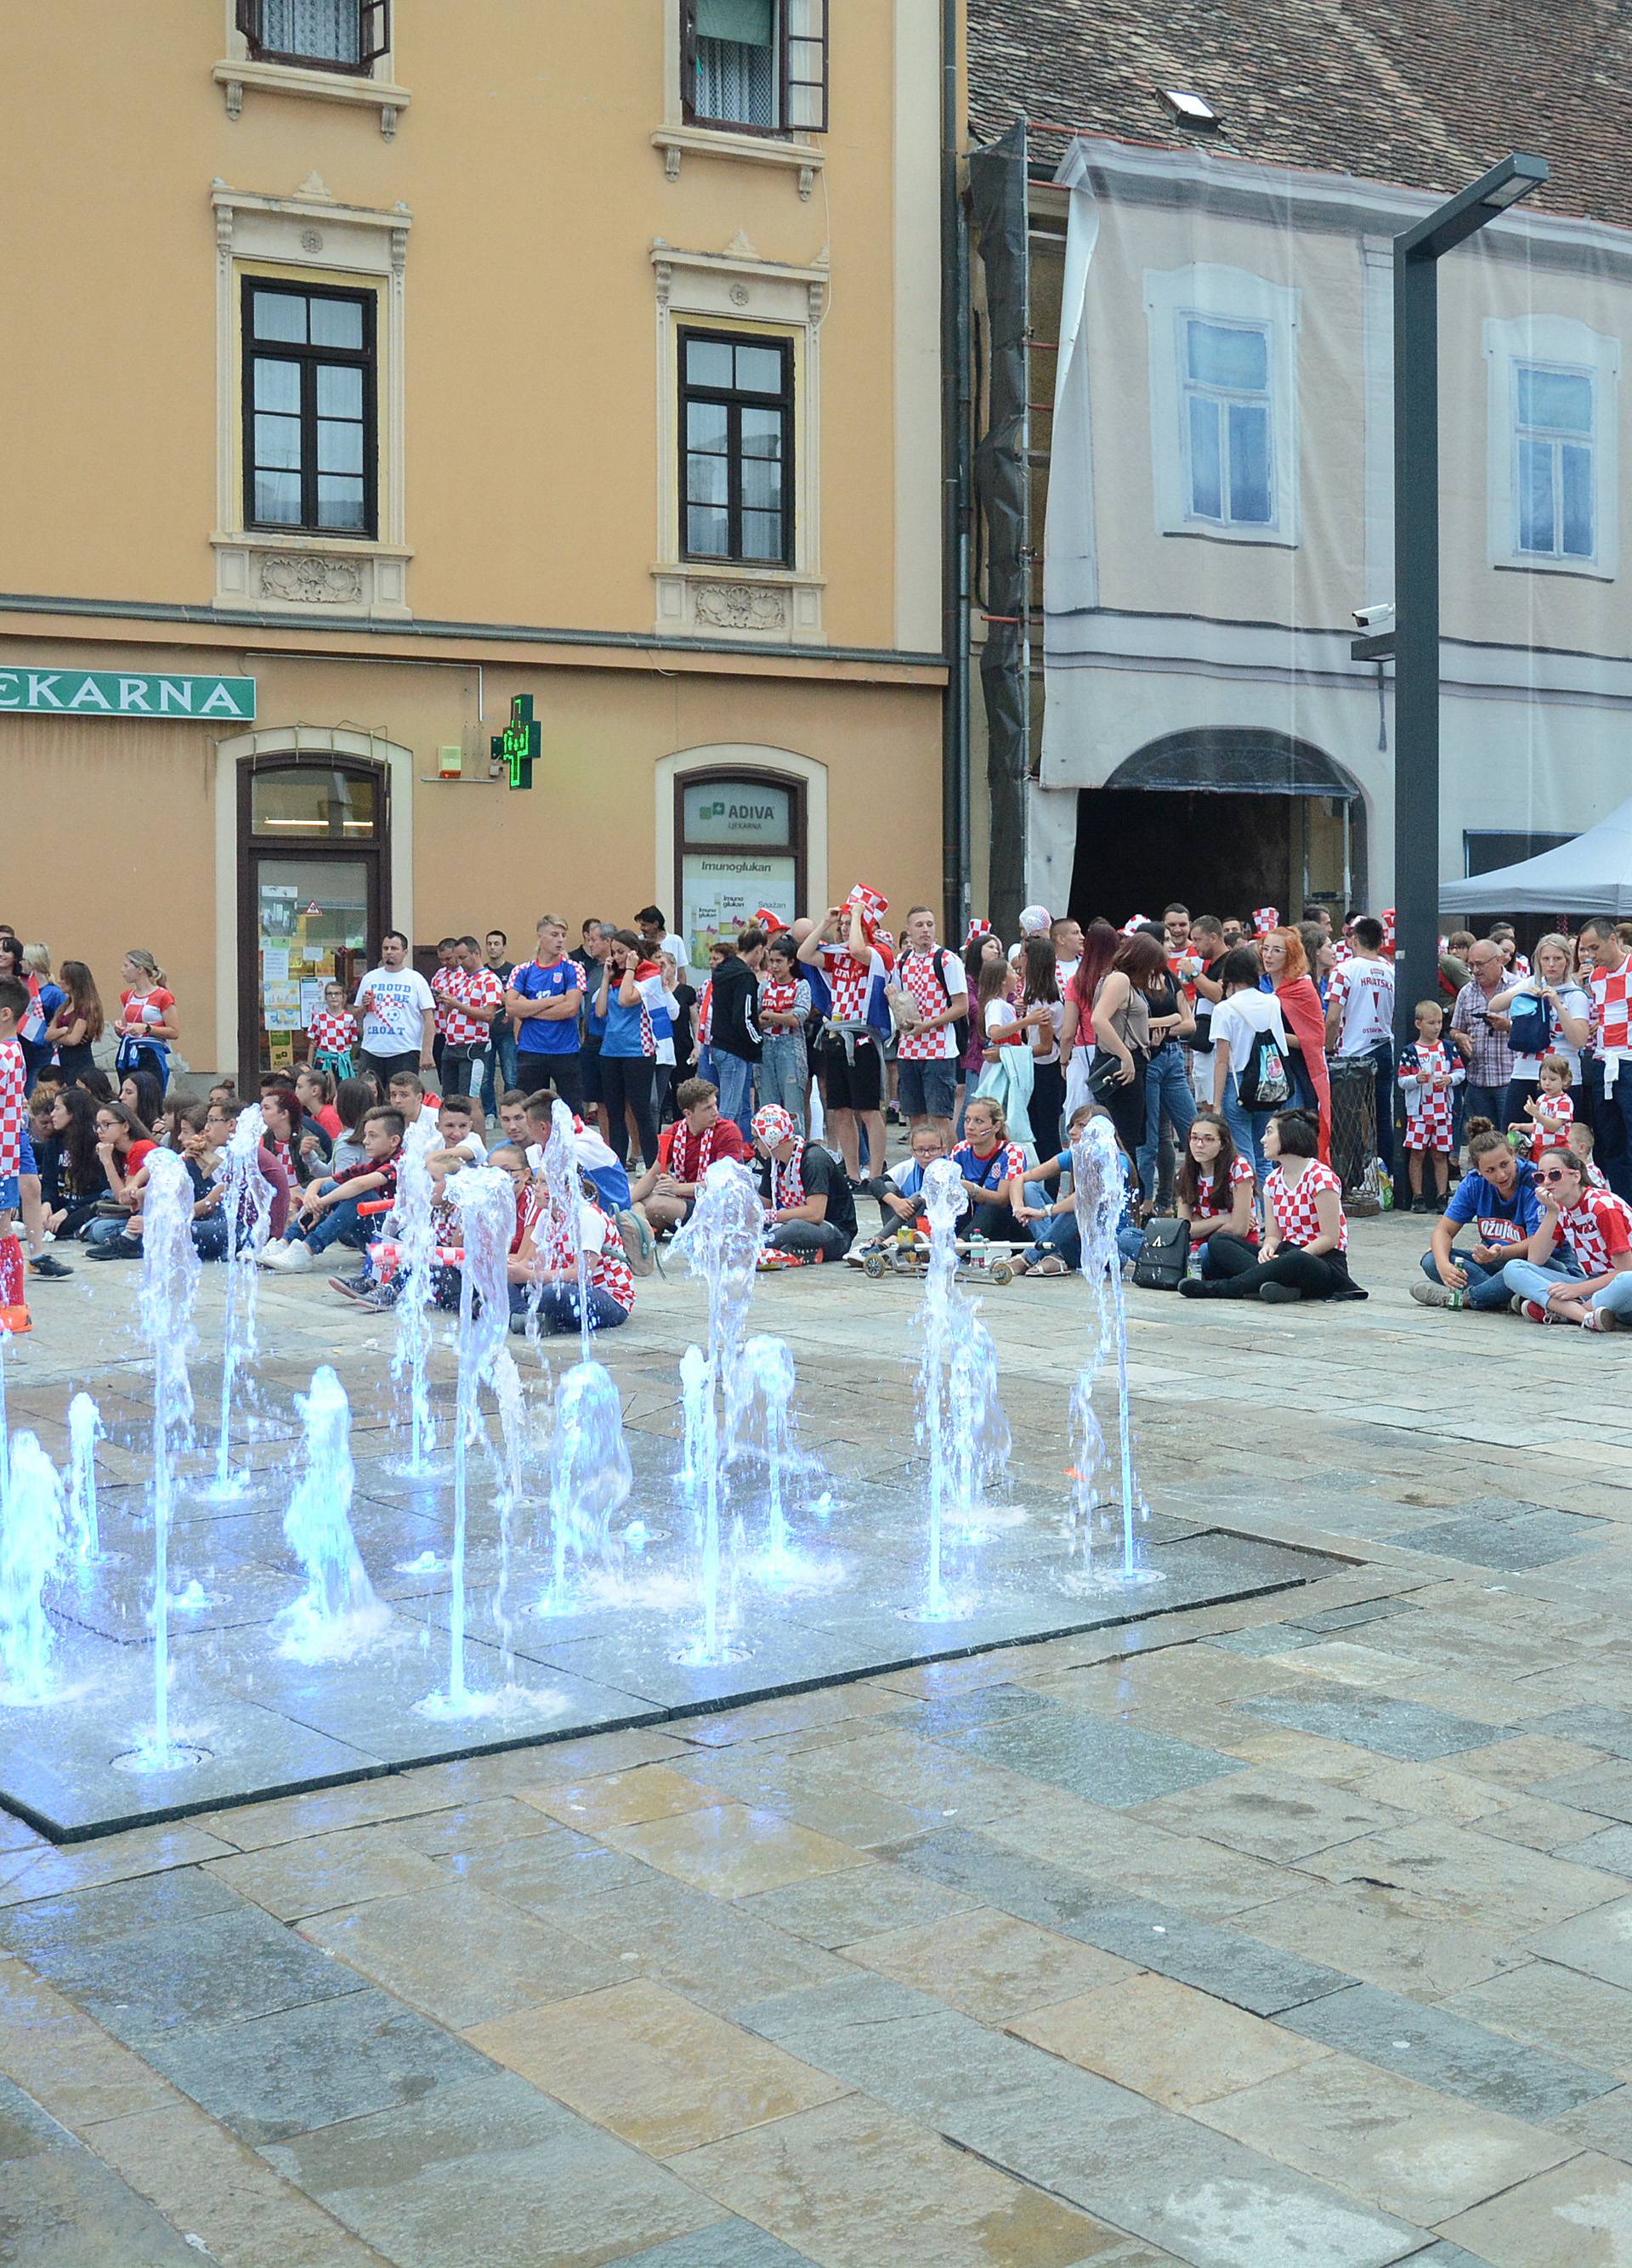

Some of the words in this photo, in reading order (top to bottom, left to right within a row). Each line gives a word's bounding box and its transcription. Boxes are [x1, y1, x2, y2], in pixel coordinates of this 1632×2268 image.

[728, 805, 774, 819] ADIVA
[701, 861, 772, 874] Imunoglukan
[371, 983, 411, 993] PROUD
[1360, 976, 1394, 993] HRATSKA
[394, 993, 410, 1003] BE
[1481, 1219, 1522, 1242] Ožujo
